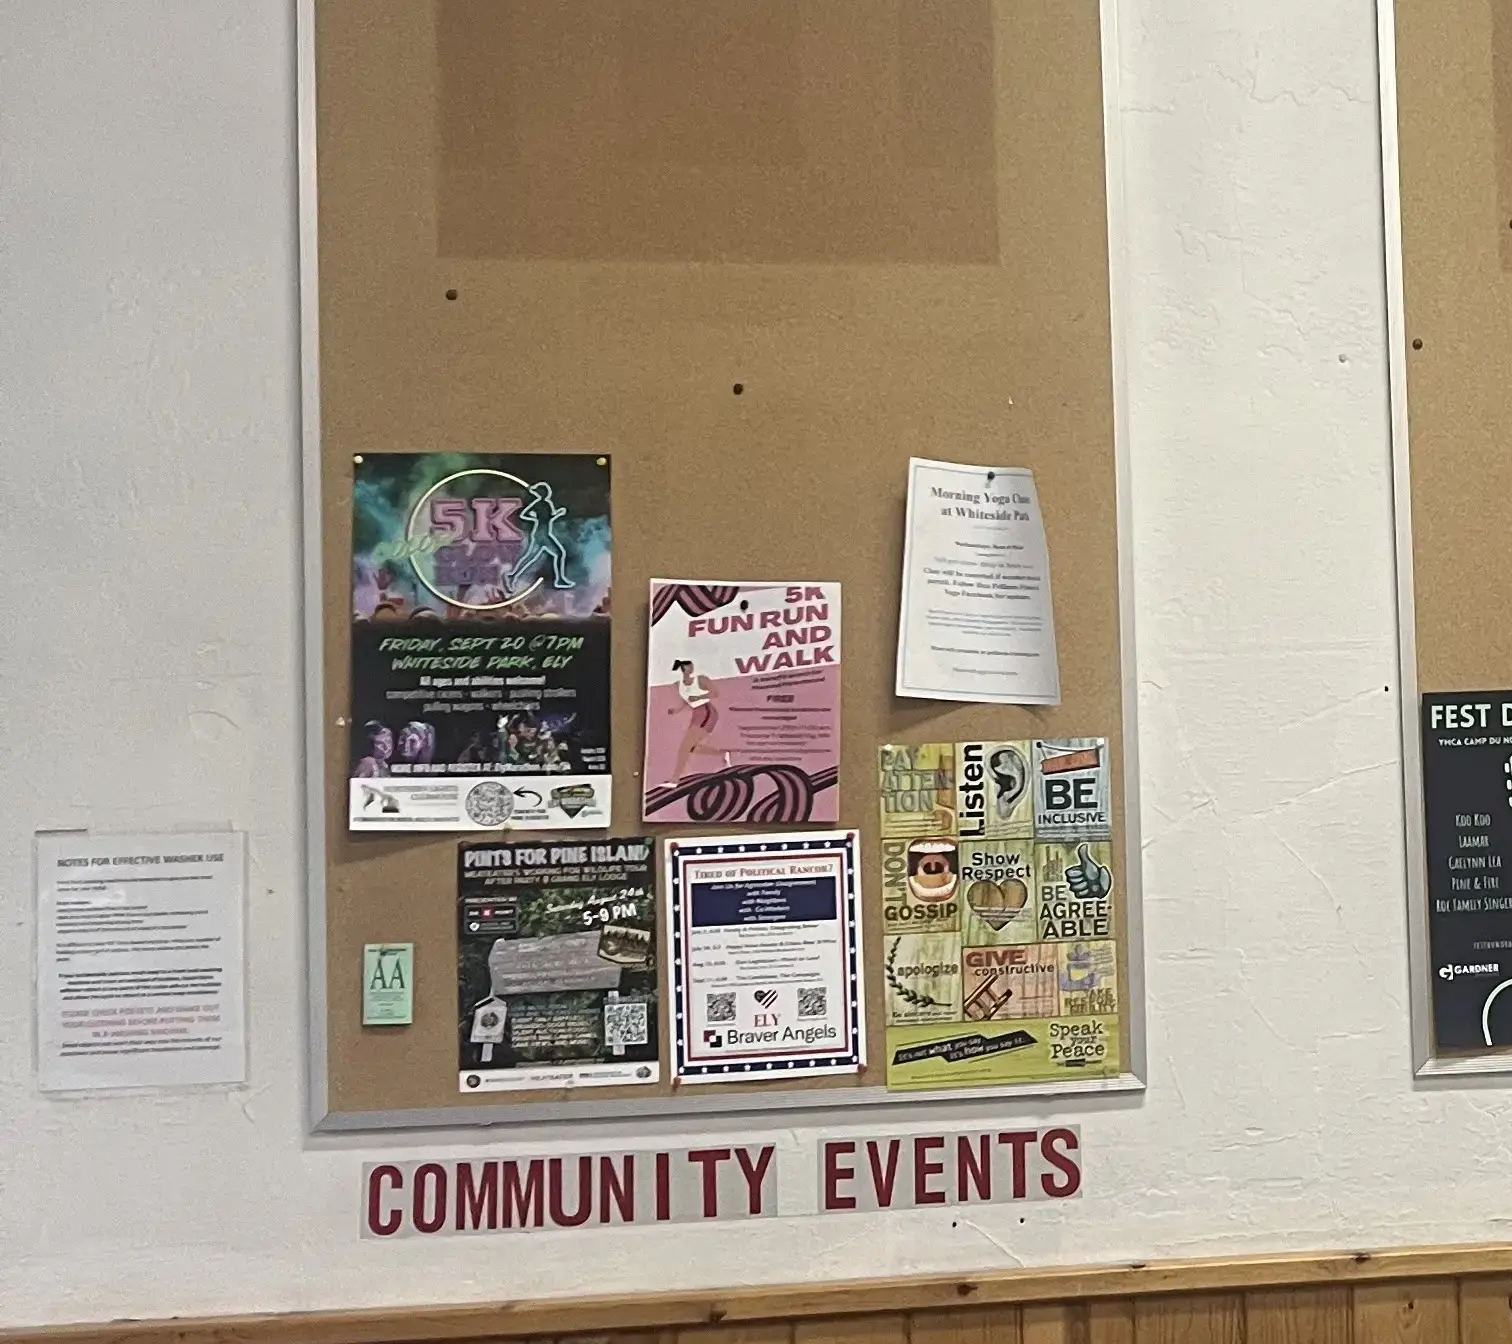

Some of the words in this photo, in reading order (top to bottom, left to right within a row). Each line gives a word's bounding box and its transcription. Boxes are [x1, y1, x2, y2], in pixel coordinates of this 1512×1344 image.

[931, 487, 981, 504] Morning
[984, 493, 1011, 505] Yoga
[430, 498, 523, 542] 5K
[941, 507, 952, 516] at
[955, 507, 1012, 521] Whiteside
[785, 586, 826, 603] 5K
[688, 614, 754, 638] FUN
[760, 603, 829, 629] RUN
[448, 637, 498, 651] SEPT
[501, 636, 525, 650] 20
[762, 625, 832, 651] AND
[391, 655, 482, 671] WHITESIDE
[542, 656, 573, 669] ELY
[735, 645, 834, 674] WALK
[1431, 703, 1492, 729] FEST
[1439, 738, 1462, 746] YMCA
[1464, 737, 1487, 745] CAMP
[1489, 736, 1501, 744] DU
[959, 744, 986, 837] Listen
[1045, 777, 1098, 810] BE
[1038, 812, 1107, 824] INCLUSIVE
[464, 849, 512, 867] PINTS
[515, 848, 547, 866] FOR
[551, 846, 587, 864] PINE
[591, 844, 650, 863] ISLAND
[972, 852, 1020, 866] Show
[884, 842, 907, 905] DON'T
[962, 864, 1031, 881] Respect
[1041, 885, 1066, 901] BE
[611, 903, 637, 920] PM
[884, 903, 957, 921] GOSSIP
[1042, 920, 1108, 939] ABLE
[966, 949, 1028, 968] GIVE
[370, 959, 405, 989] AA
[897, 961, 959, 979] apologize
[974, 962, 1055, 977] constructive
[1454, 963, 1499, 974] GARDNER
[754, 1013, 779, 1028] ELY
[1050, 1020, 1103, 1037] Speak
[728, 1029, 778, 1045] Braver
[782, 1024, 837, 1044] Angels
[1051, 1043, 1105, 1059] Peace
[368, 1146, 775, 1236] COMMUNITY
[825, 1128, 1081, 1209] EVENTS
